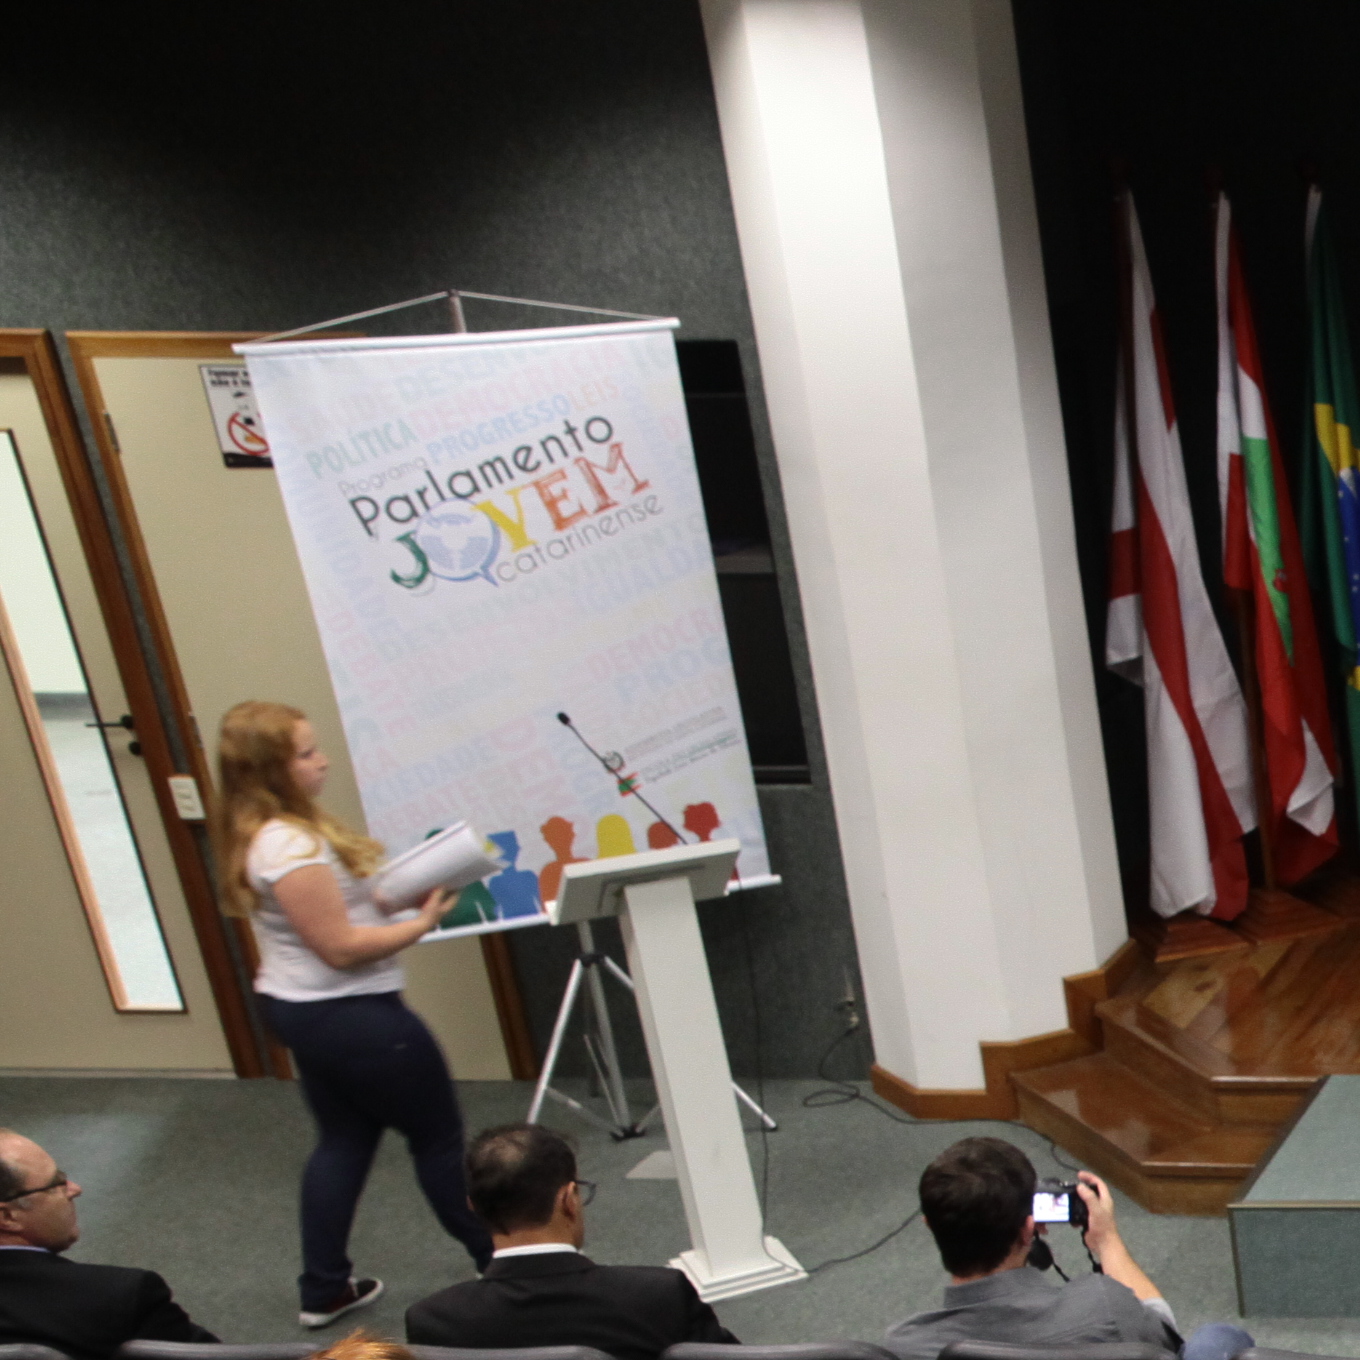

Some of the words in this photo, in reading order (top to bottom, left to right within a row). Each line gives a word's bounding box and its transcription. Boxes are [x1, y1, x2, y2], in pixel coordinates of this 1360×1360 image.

[305, 417, 418, 480] POLÍTICA
[425, 393, 572, 466] PROGRESSO
[348, 414, 616, 539] Parlamento
[494, 492, 664, 583] catarinense
